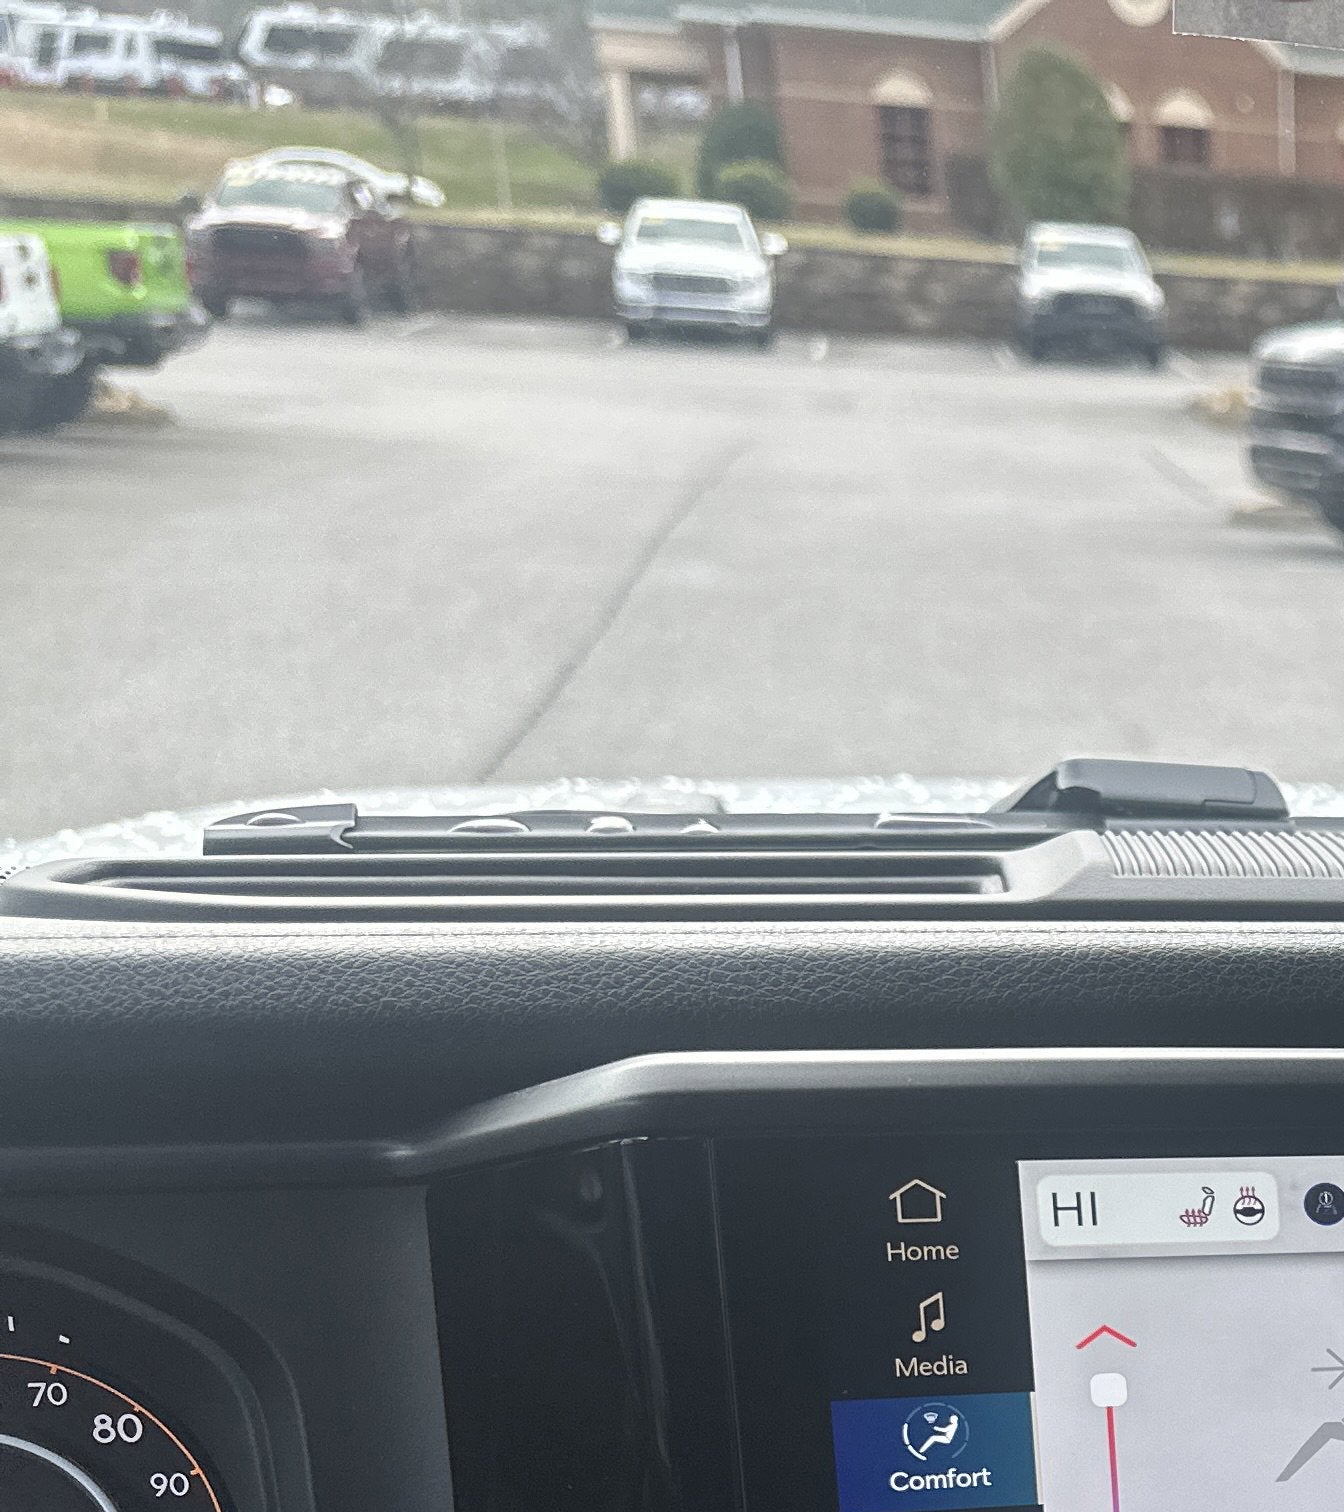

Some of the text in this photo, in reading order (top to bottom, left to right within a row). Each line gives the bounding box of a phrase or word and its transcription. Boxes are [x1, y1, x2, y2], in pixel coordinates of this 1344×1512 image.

[1051, 1193, 1098, 1228] HI
[886, 1241, 960, 1263] Home
[895, 1355, 969, 1378] Media
[28, 1383, 67, 1406] 70
[92, 1413, 143, 1443] 80
[150, 1473, 190, 1497] 90
[889, 1467, 991, 1492] Comfort
